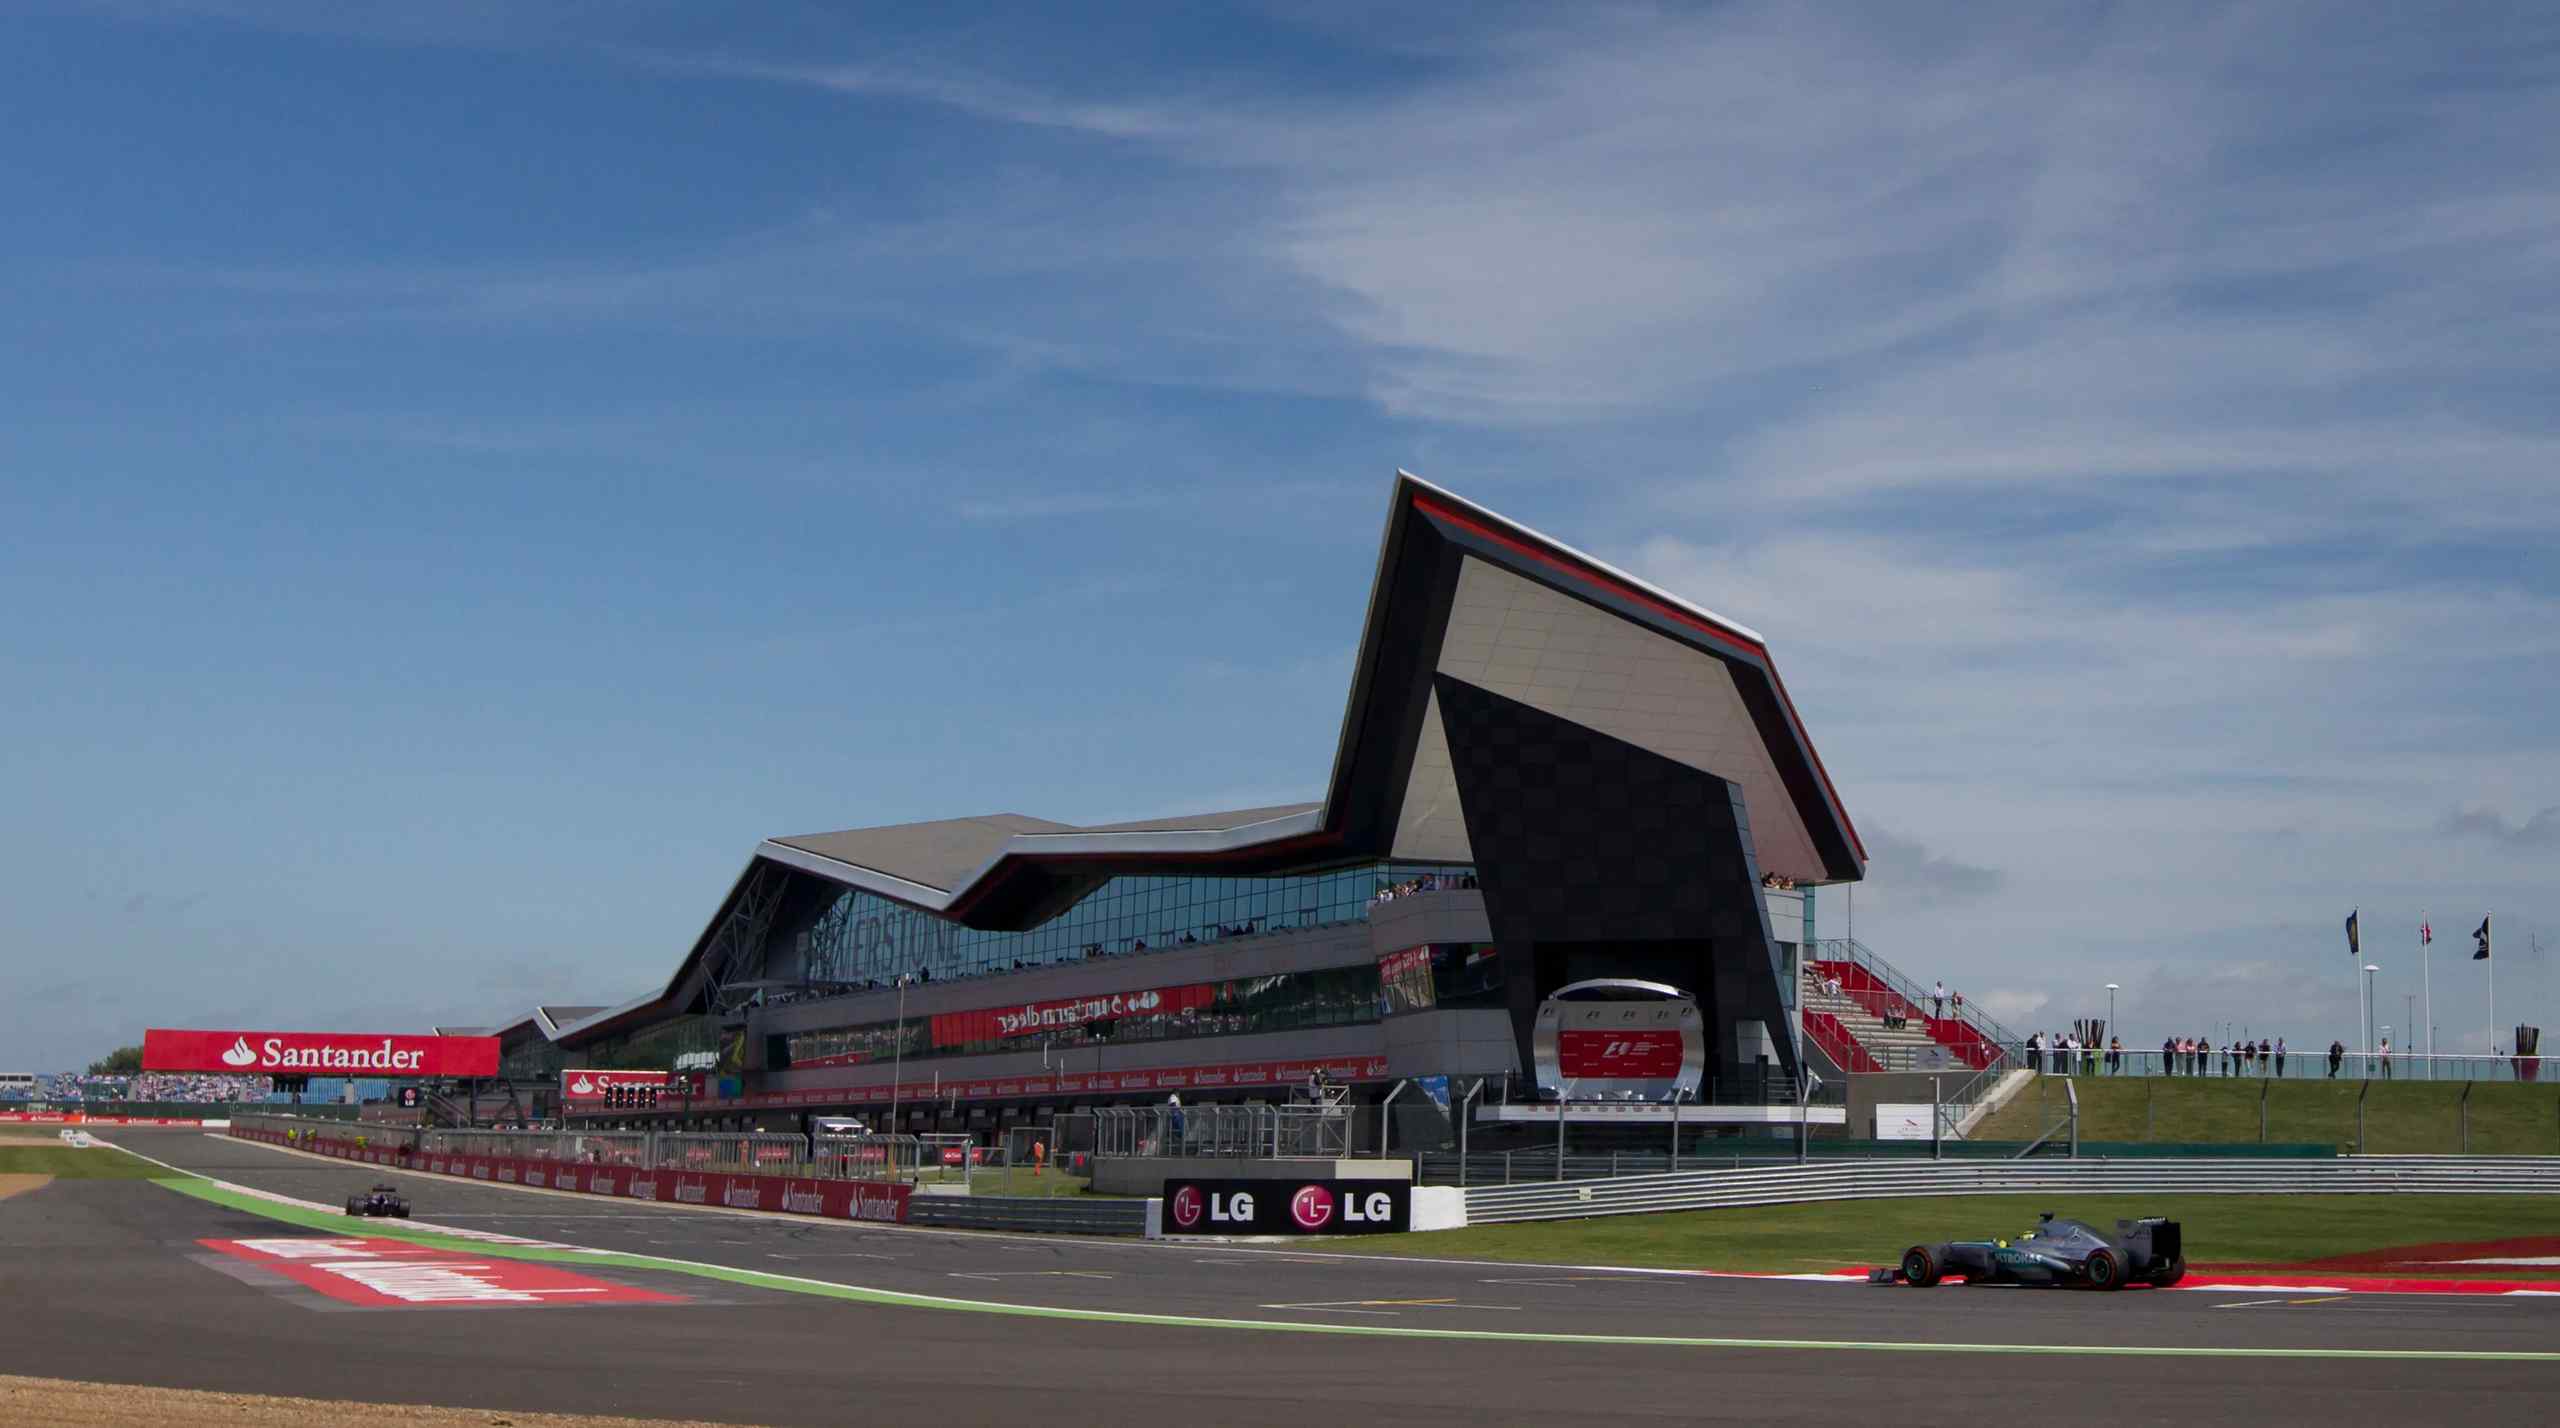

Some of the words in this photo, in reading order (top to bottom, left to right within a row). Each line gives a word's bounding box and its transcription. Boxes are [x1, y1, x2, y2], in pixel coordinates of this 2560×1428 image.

[262, 1039, 424, 1069] Santander
[1211, 1193, 1254, 1221] LG
[1344, 1193, 1391, 1221] LG
